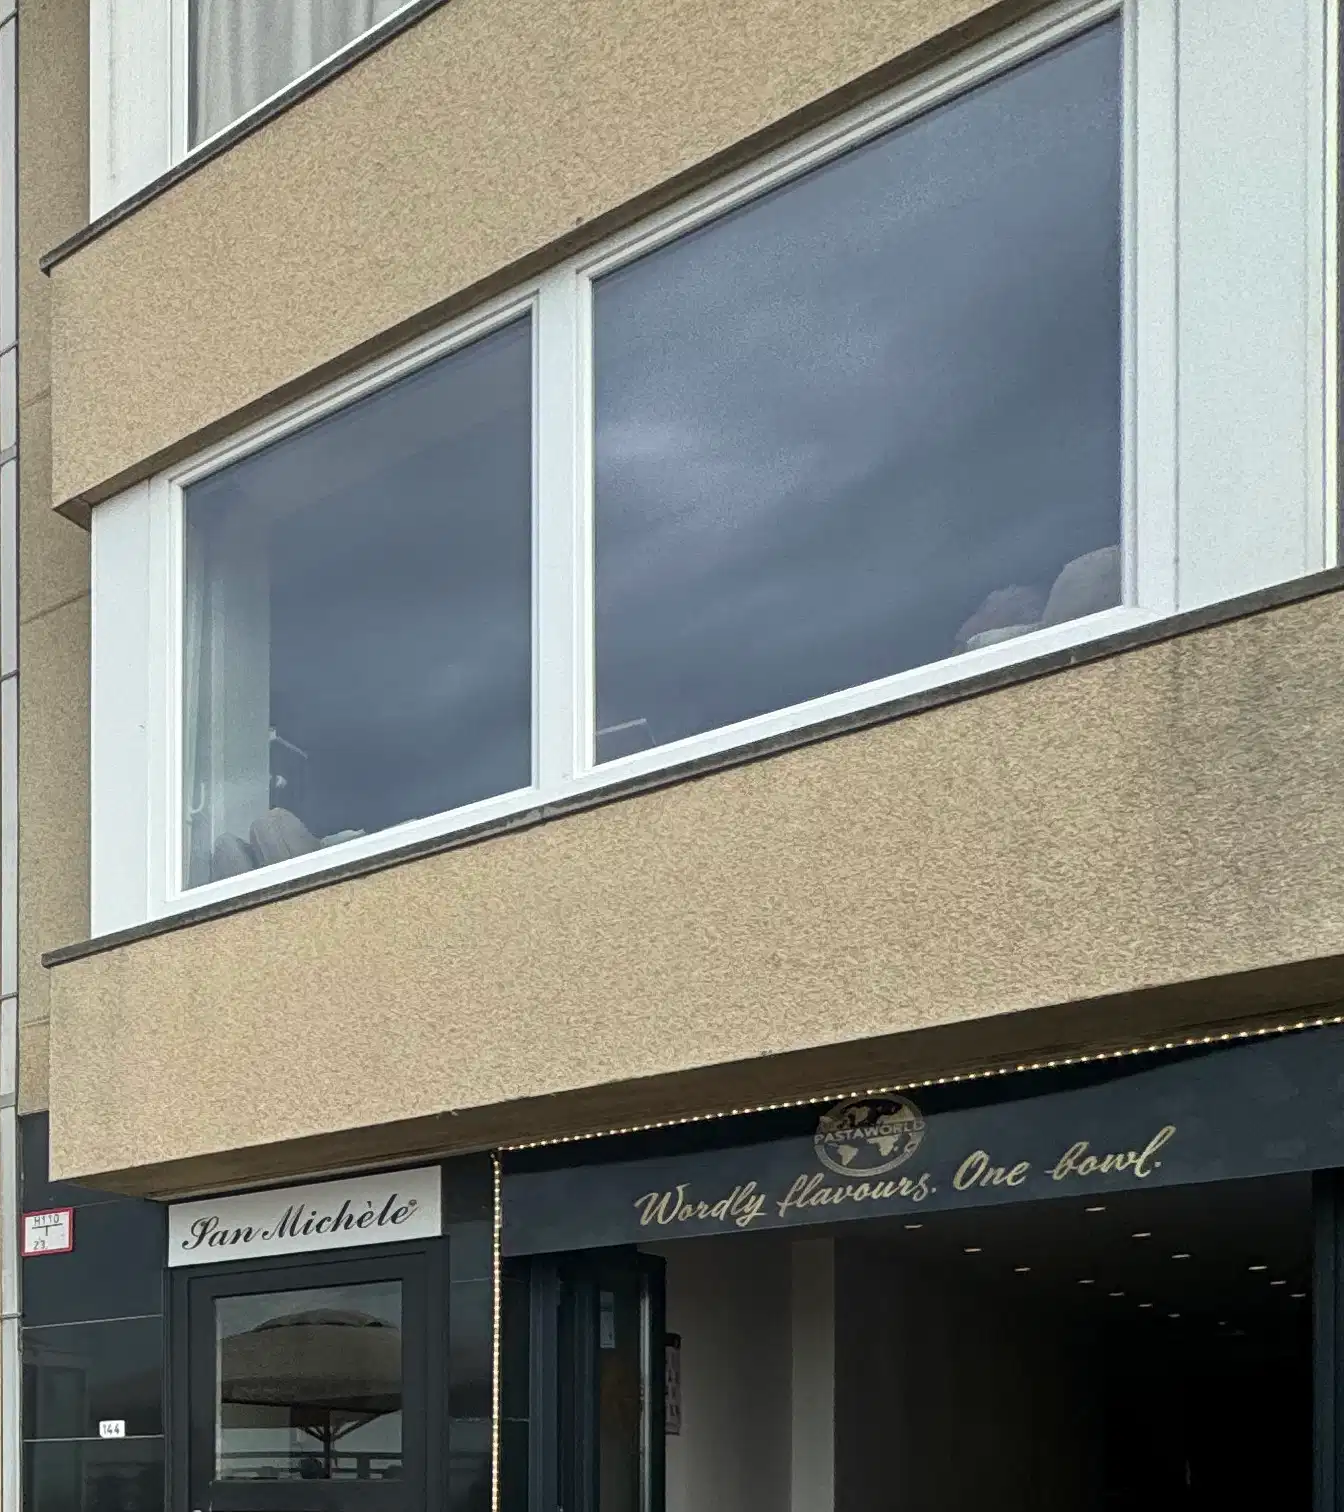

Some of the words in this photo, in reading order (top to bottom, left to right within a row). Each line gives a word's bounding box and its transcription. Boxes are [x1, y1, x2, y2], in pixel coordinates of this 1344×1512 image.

[814, 1120, 926, 1145] PASTAWORLD
[633, 1181, 767, 1227] Wordly
[777, 1172, 936, 1217] flavours.
[953, 1150, 1030, 1190] One
[1044, 1125, 1176, 1180] bowl.
[181, 1215, 258, 1250] San
[102, 1423, 119, 1435] 144
